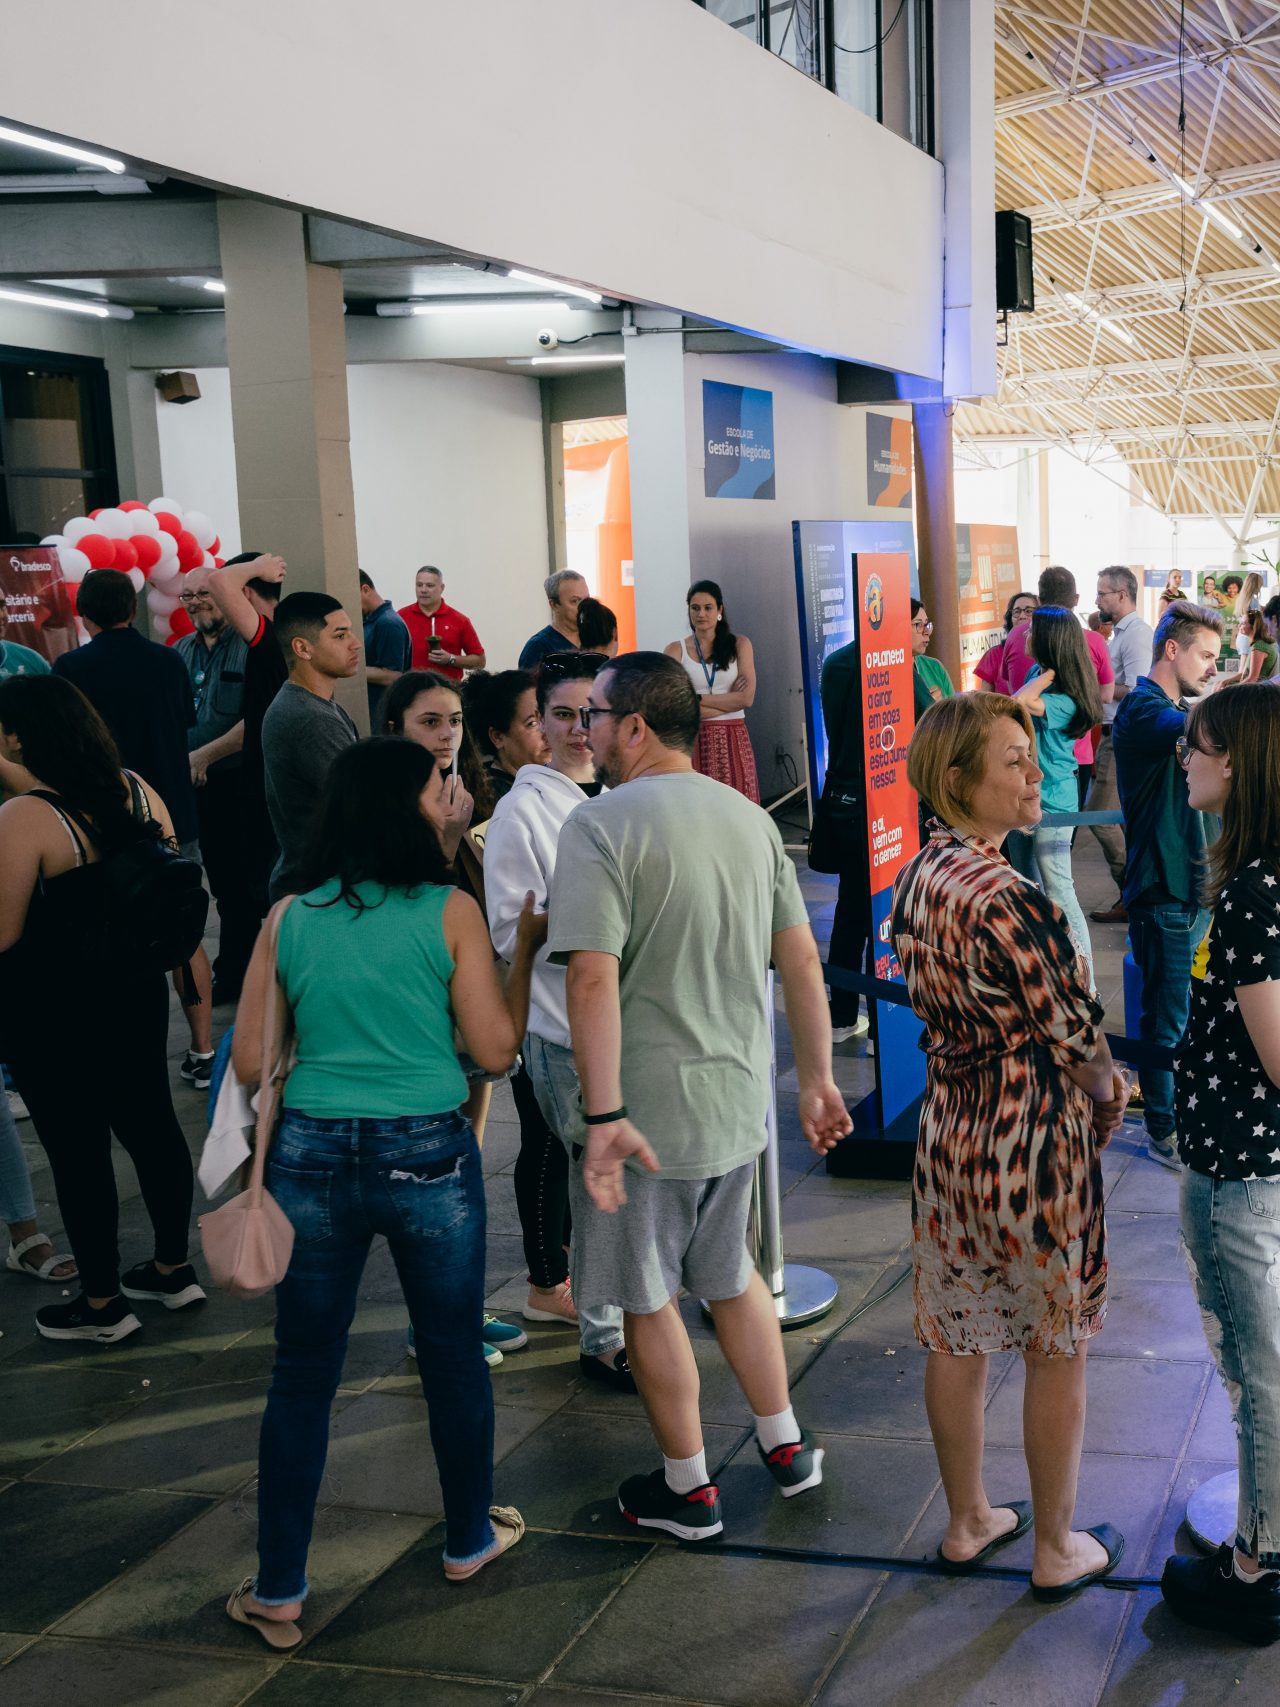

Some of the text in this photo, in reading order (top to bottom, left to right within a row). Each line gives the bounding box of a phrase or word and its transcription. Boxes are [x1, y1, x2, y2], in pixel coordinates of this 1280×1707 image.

[726, 427, 754, 439] ESCOLA DE
[708, 439, 771, 462] Gestão e Negócios
[20, 561, 52, 571] bradesco
[5, 593, 40, 606] sitário e
[7, 610, 36, 623] arceria
[868, 708, 900, 729] em 2023
[869, 735, 874, 750] e
[875, 733, 881, 748] a
[870, 768, 897, 790] nessa!
[872, 820, 878, 834] e
[873, 826, 902, 850] vem com
[873, 853, 879, 868] a
